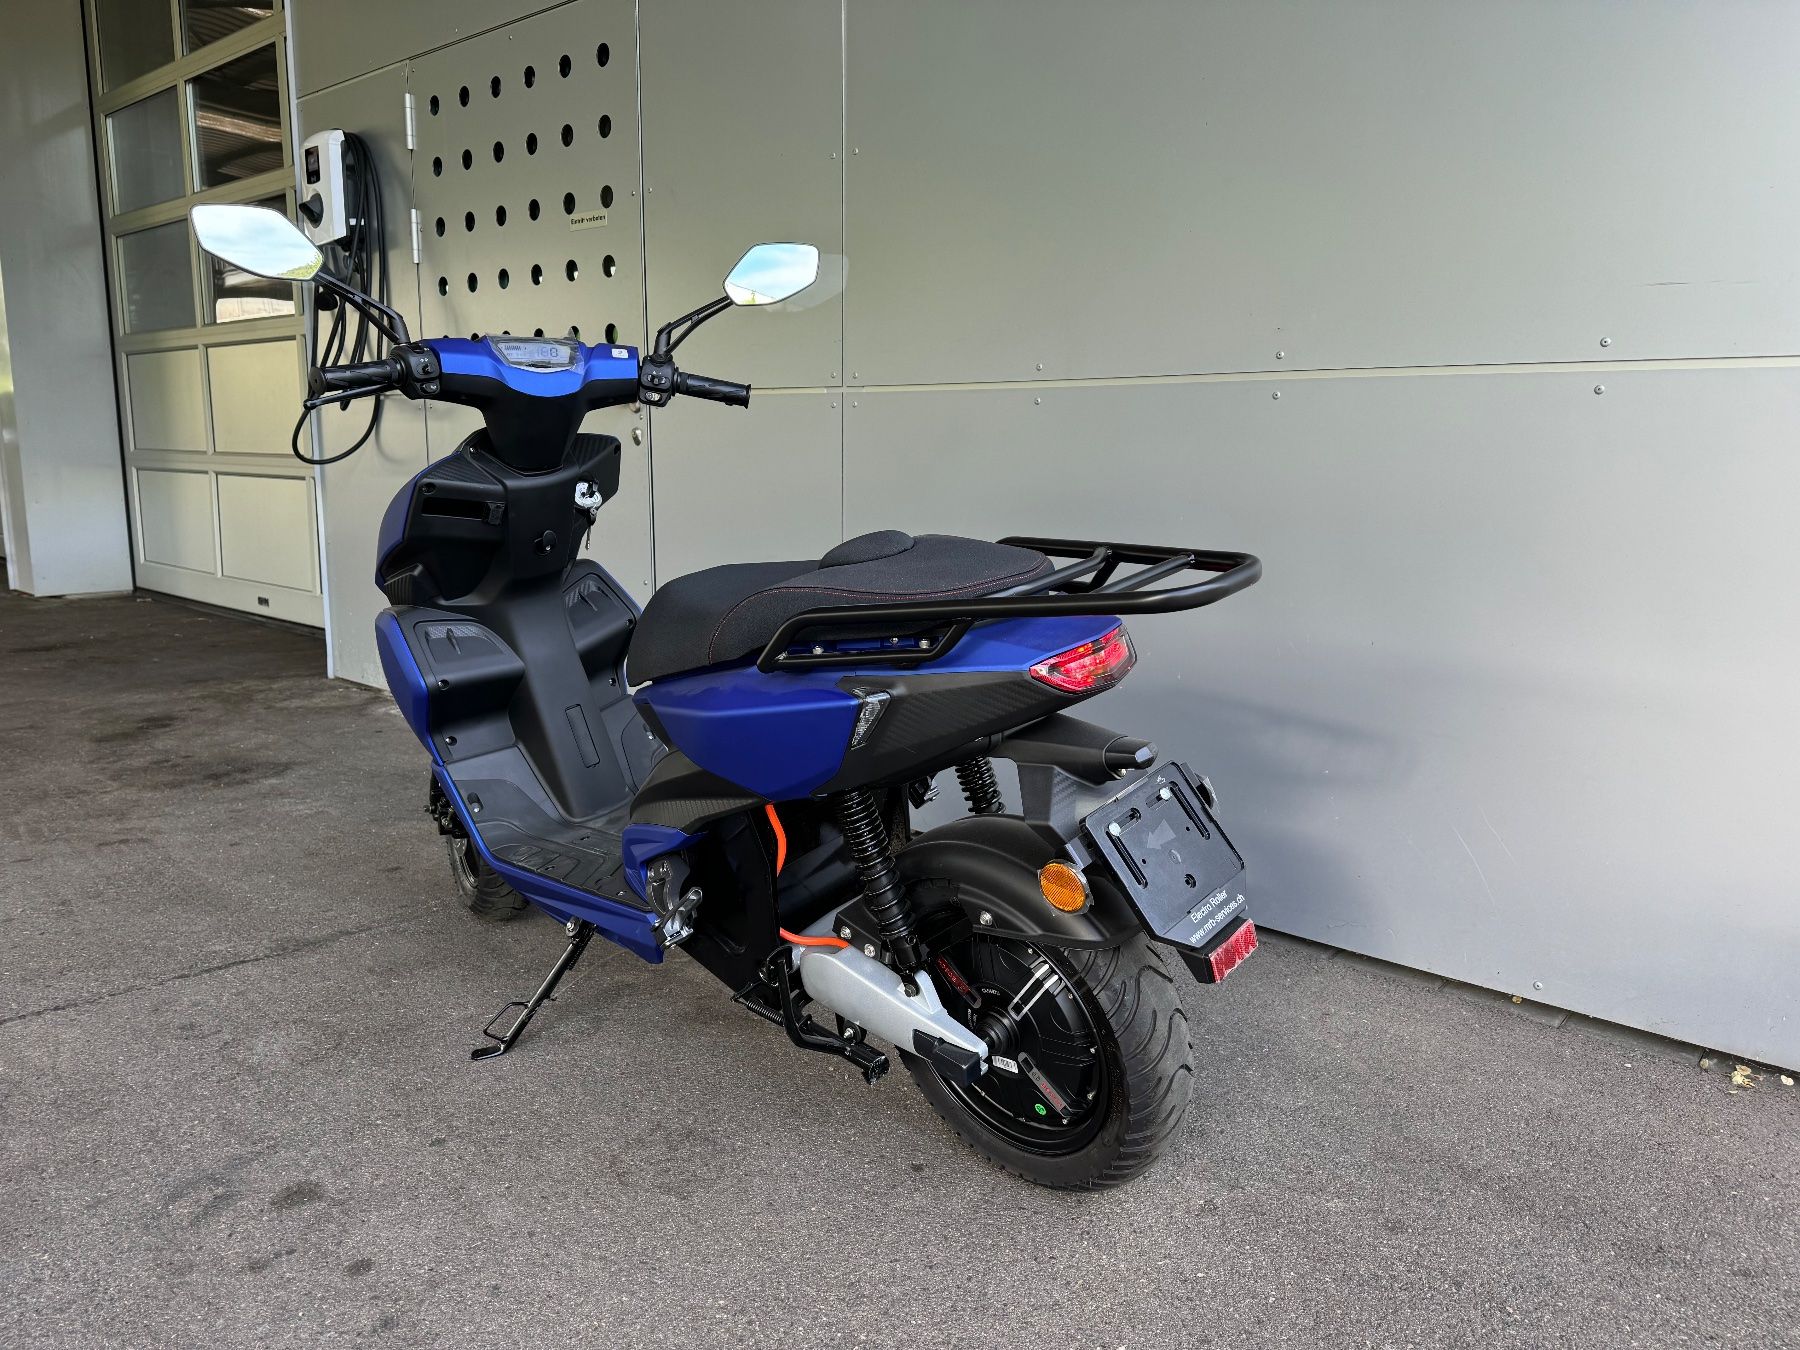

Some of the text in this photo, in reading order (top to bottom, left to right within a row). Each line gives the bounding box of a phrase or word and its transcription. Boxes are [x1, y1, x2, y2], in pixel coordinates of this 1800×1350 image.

[1189, 894, 1245, 943] www.mrb-services.ch
[1190, 891, 1227, 923] Electro Roller
